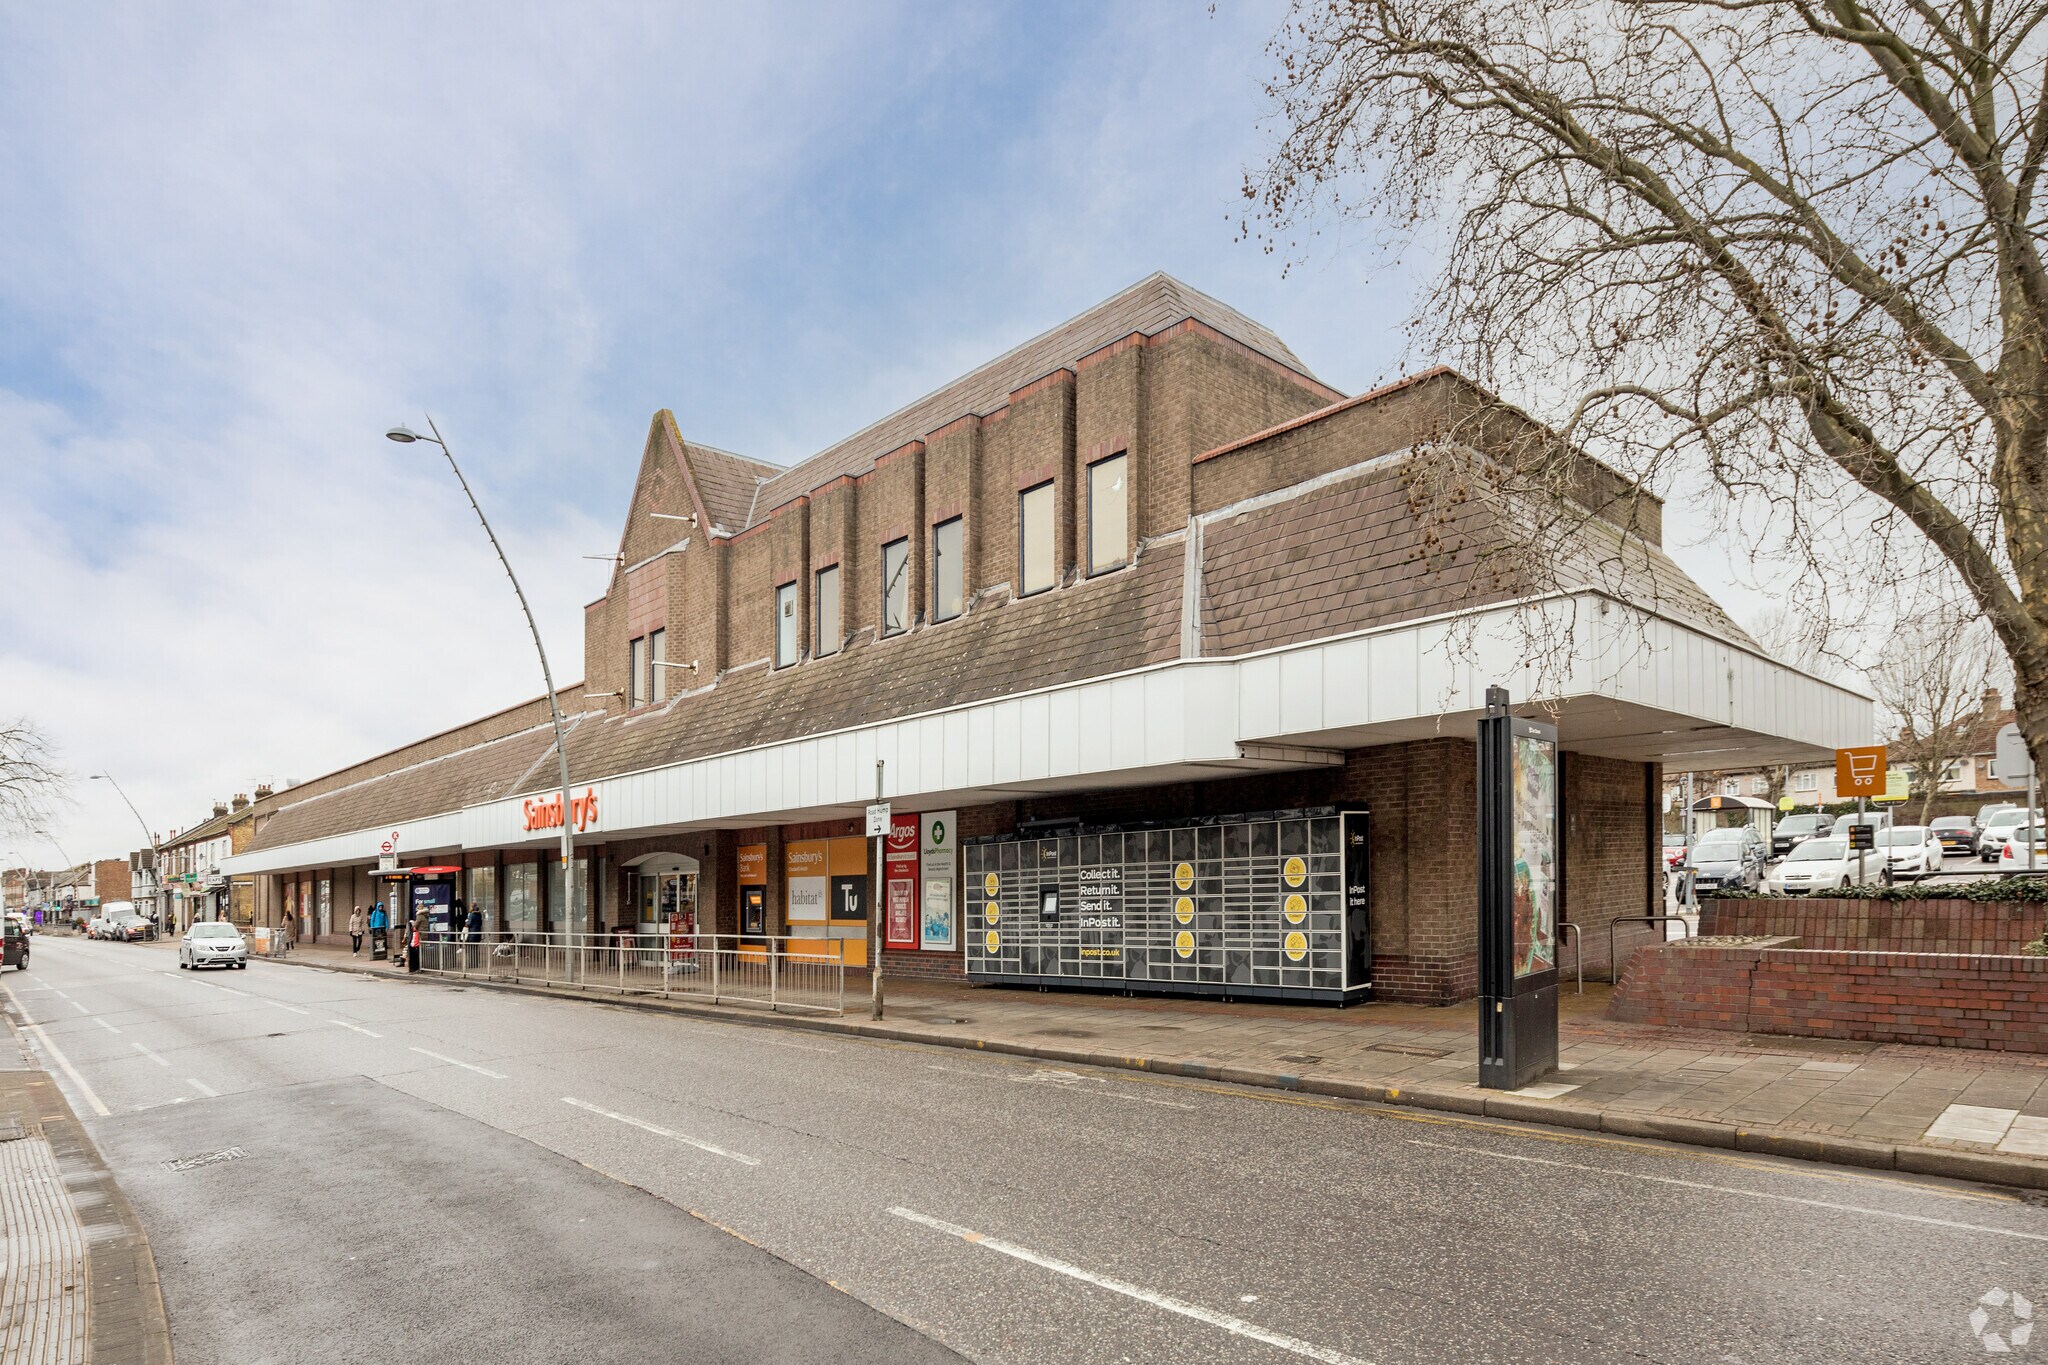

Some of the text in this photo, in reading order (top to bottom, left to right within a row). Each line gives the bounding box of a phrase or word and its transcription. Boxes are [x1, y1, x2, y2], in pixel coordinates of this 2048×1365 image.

[523, 787, 598, 832] Sainsbry's
[888, 823, 915, 842] Argos
[740, 852, 764, 863] Sainsbury's
[788, 850, 823, 865] Sainsbury's
[1080, 868, 1121, 880] Collect it.
[1080, 884, 1120, 896] Return it.
[1349, 885, 1366, 895] InPost
[791, 890, 818, 905] habitat
[841, 883, 858, 912] Tu
[1354, 897, 1366, 906] here
[1080, 900, 1113, 911] Send it.
[1080, 917, 1121, 927] InPost it.
